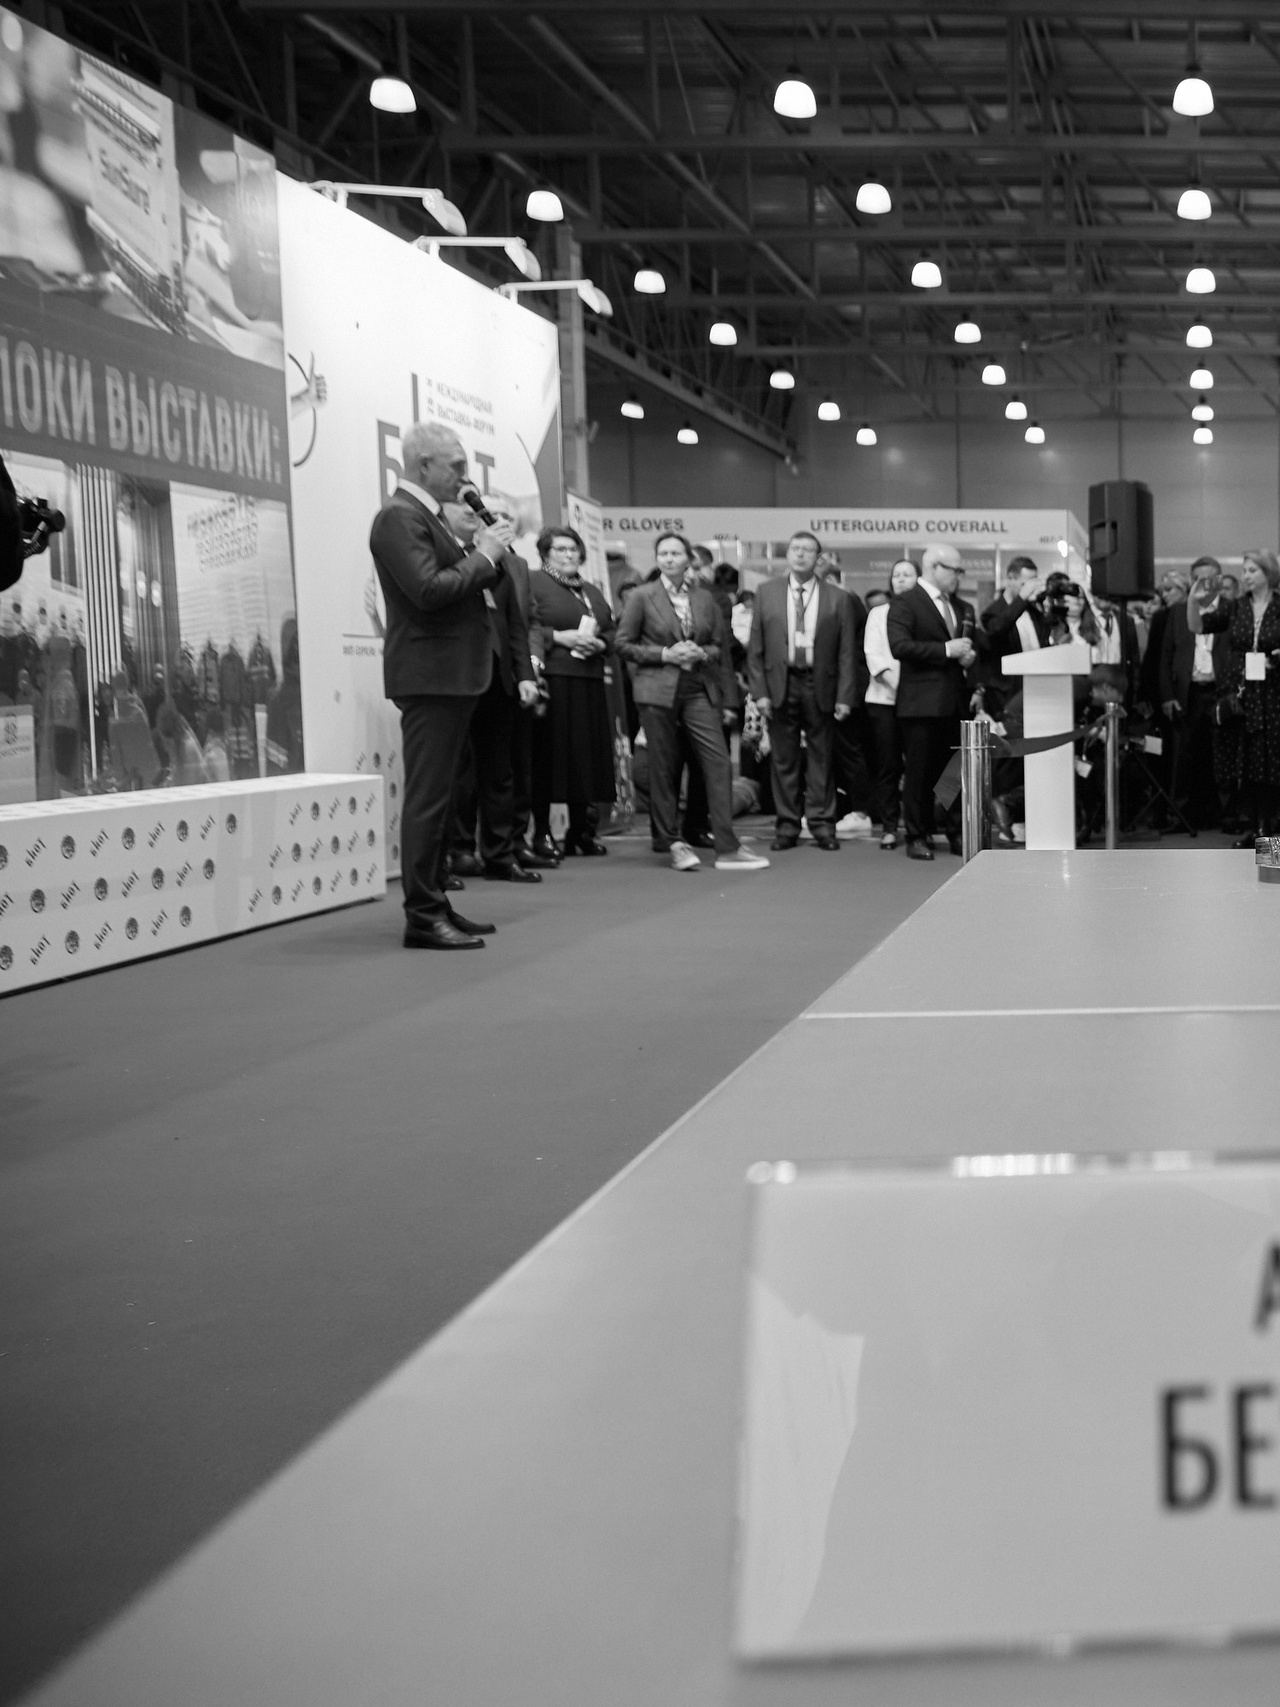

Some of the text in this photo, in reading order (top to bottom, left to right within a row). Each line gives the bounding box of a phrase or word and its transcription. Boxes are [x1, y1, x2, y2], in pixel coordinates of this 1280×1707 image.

[104, 363, 283, 485] ВЫСТАВКИ:
[618, 517, 685, 532] GLOVES
[810, 519, 1009, 533] UTTERGUARD COVERALL
